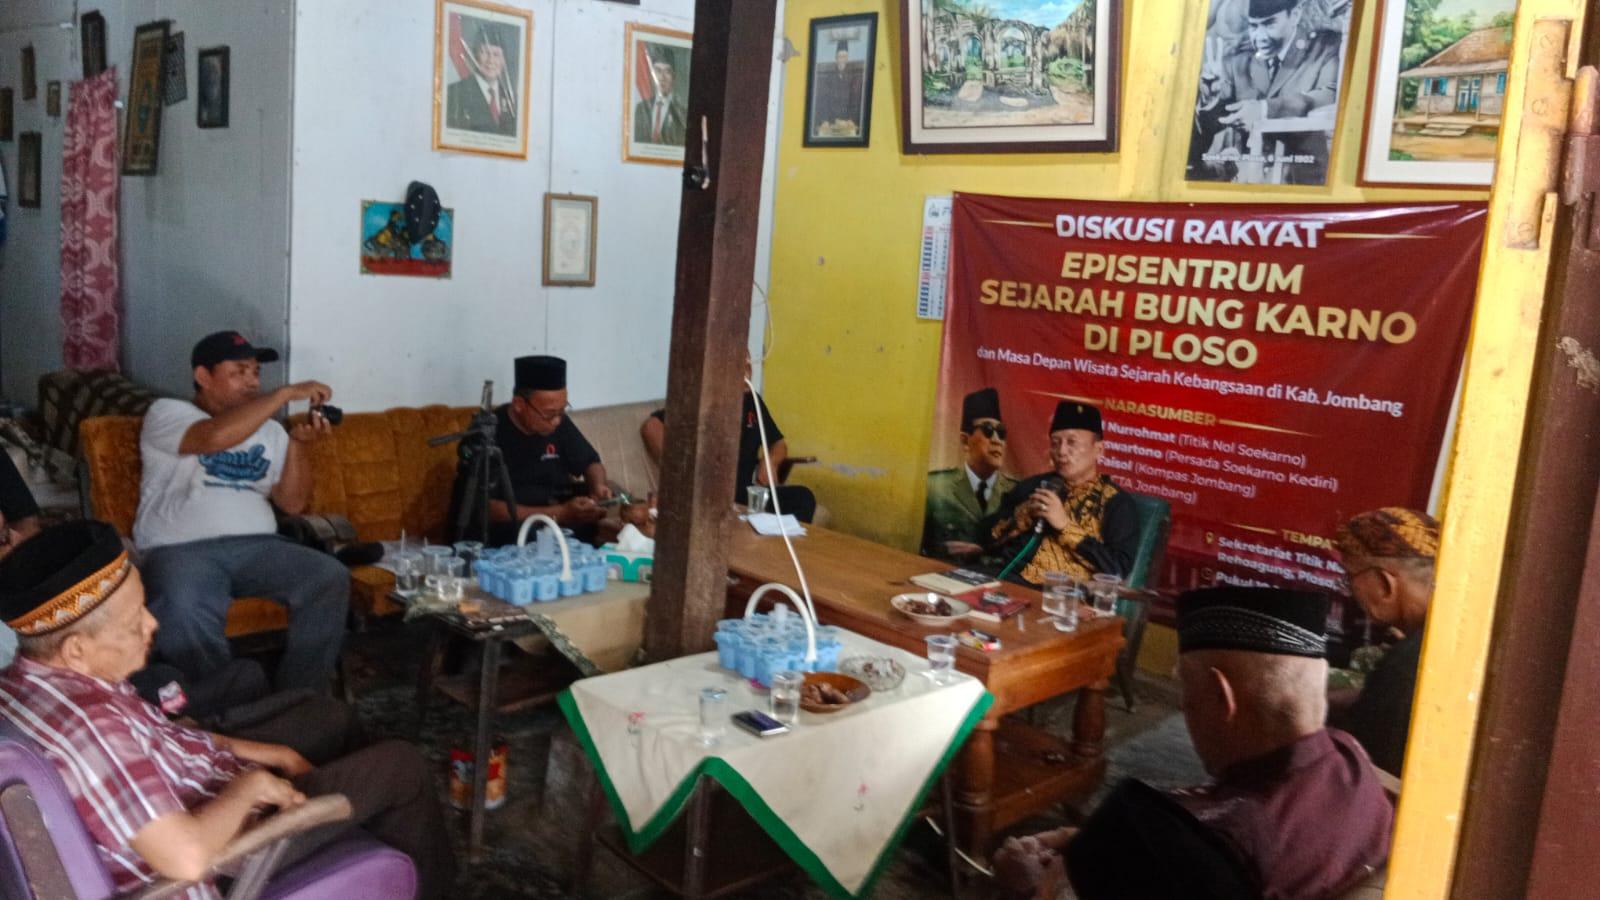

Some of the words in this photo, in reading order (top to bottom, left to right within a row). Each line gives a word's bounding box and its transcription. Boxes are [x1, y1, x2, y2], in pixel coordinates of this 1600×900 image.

[1056, 214, 1175, 243] DISKUSI
[1182, 219, 1325, 248] RAKYAT
[1060, 251, 1304, 295] EPISENTRUM
[979, 279, 1125, 318] SEJARAH
[1134, 292, 1244, 329] BUNG
[1255, 302, 1416, 344] KARNO
[1084, 323, 1118, 353] DI
[1129, 328, 1258, 369] PLOSO
[977, 345, 996, 360] dan
[997, 348, 1031, 366] Masa
[1032, 353, 1072, 371] Depan
[1073, 357, 1118, 377] Wisata
[1119, 364, 1170, 385] Sejarah
[1173, 371, 1265, 397] Kebangsaan
[1266, 383, 1283, 399] di
[1285, 386, 1319, 404] Kab.
[1322, 390, 1404, 417] Jombang
[1104, 398, 1216, 426] NARASUMBER
[1107, 421, 1175, 444] Nurrohmat
[1178, 432, 1210, 449] (Titik
[1212, 439, 1236, 454] Nol
[1237, 443, 1307, 469] Soekarno)
[1135, 461, 1190, 482] (Kompas
[1190, 471, 1256, 499] Jombang)
[1135, 479, 1198, 505] Jombang)
[1165, 449, 1220, 470] (Persada
[1221, 460, 1286, 483] Soekarno
[1288, 472, 1339, 494] Kediri)
[1218, 536, 1293, 562] Sekretariat
